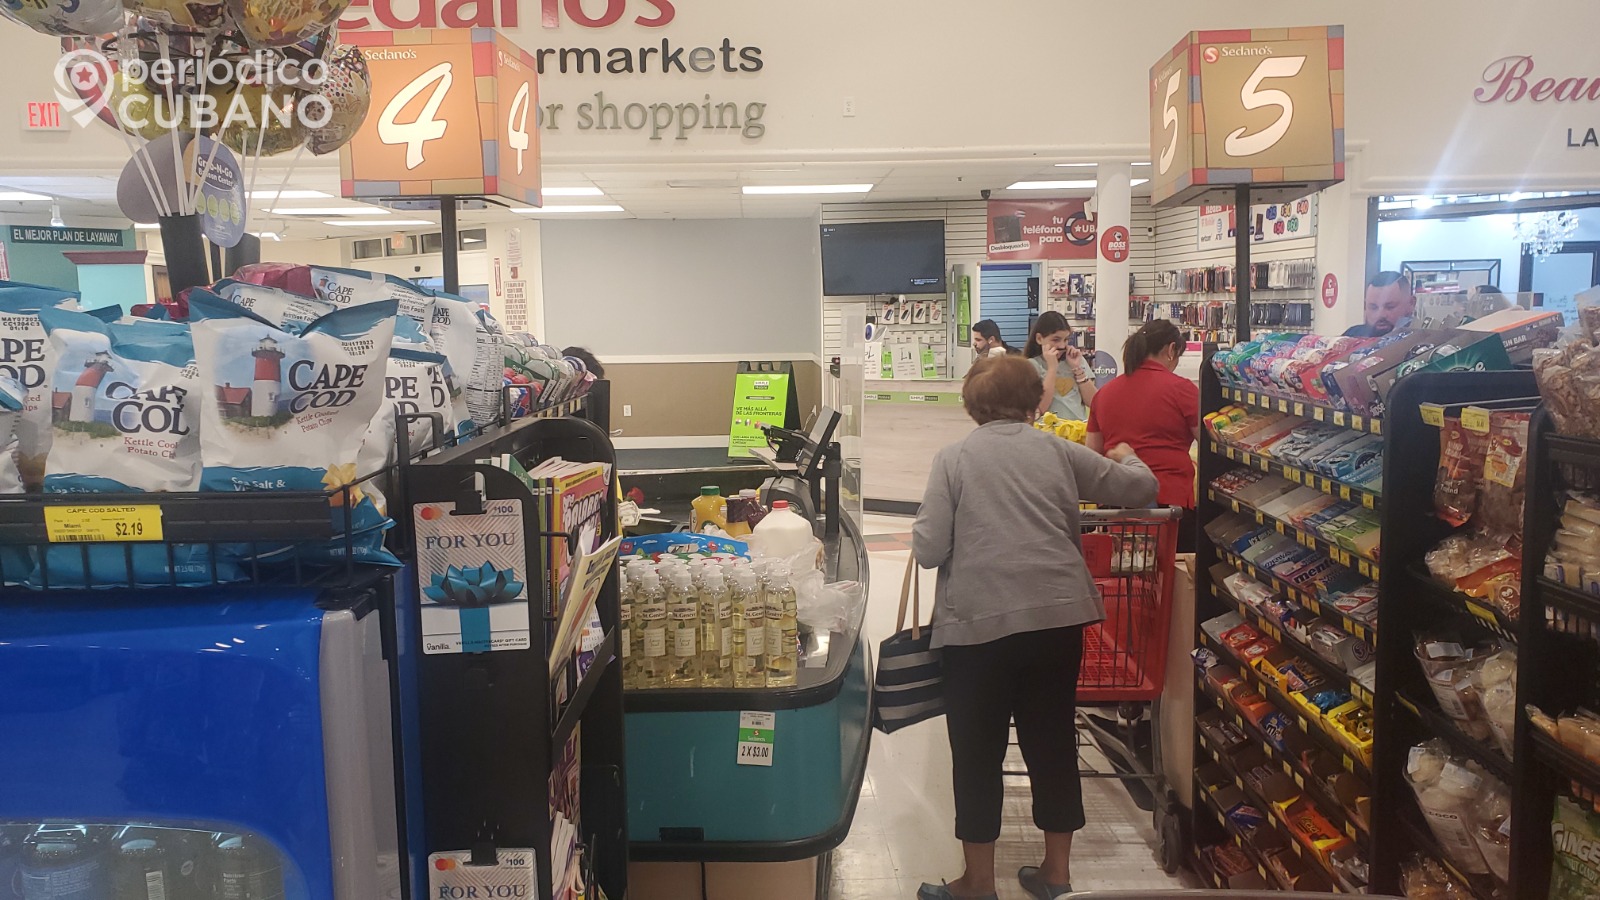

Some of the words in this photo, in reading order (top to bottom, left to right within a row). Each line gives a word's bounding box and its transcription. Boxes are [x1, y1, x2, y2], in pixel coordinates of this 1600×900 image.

[365, 48, 417, 60] Sedano's
[1221, 45, 1273, 57] Sedano's
[1224, 55, 1308, 157] 5
[28, 102, 60, 127] EXIT
[377, 62, 453, 170] 4
[577, 91, 767, 140] shopping
[507, 81, 529, 175] 4
[1159, 68, 1182, 175] 5
[1567, 127, 1599, 148] LA
[197, 156, 233, 179] Grb-N-Go
[1052, 215, 1064, 224] tu
[13, 228, 24, 240] EL
[25, 229, 52, 241] MEJOR
[53, 230, 73, 242] PLAN
[74, 231, 85, 242] DE
[86, 231, 119, 243] LAYAWAY
[1022, 225, 1063, 234] teléfono
[990, 242, 1029, 252] Desbloqueados
[1039, 235, 1063, 246] para
[327, 281, 354, 295] CAPE
[327, 292, 351, 305] COD
[0, 337, 46, 363] PE
[288, 359, 369, 392] CAPE
[289, 390, 357, 414] COD
[296, 413, 313, 425] Kettle
[300, 423, 319, 433] Potato
[124, 437, 154, 447] Kettle
[127, 446, 158, 457] Potato
[252, 479, 274, 489] Salt
[276, 479, 286, 488] &
[494, 505, 514, 514] $100
[115, 522, 143, 537] $2.19
[424, 535, 467, 549] FOR
[470, 532, 515, 548] YOU
[427, 643, 451, 651] Vanilla
[741, 745, 746, 757] 2
[746, 745, 752, 757] X
[752, 746, 769, 758] $3.00
[505, 857, 525, 866] $100
[438, 885, 480, 899] FOR
[483, 884, 526, 898] YOU
